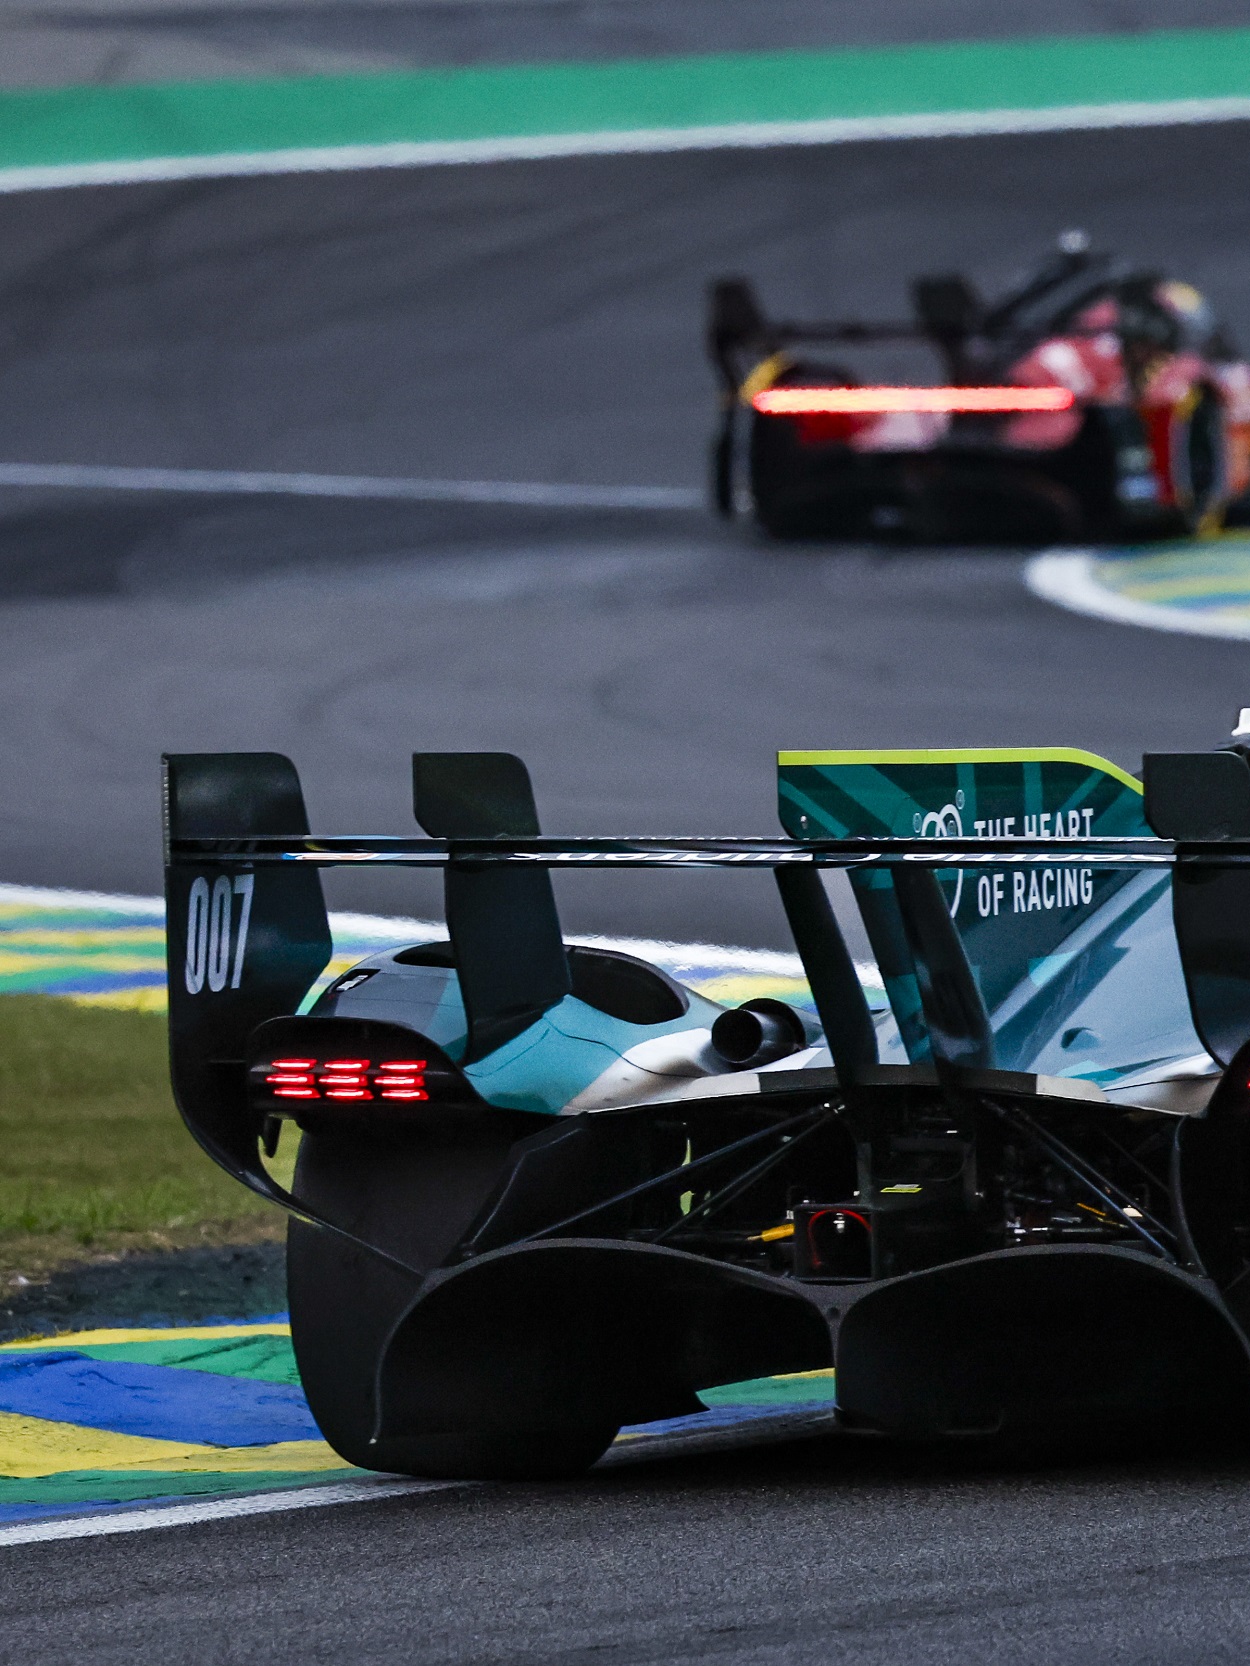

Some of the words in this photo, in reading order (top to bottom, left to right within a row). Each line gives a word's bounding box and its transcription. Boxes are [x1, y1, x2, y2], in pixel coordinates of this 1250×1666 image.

[186, 874, 255, 994] 007
[978, 873, 1005, 917] OF
[1013, 868, 1093, 913] RACING
